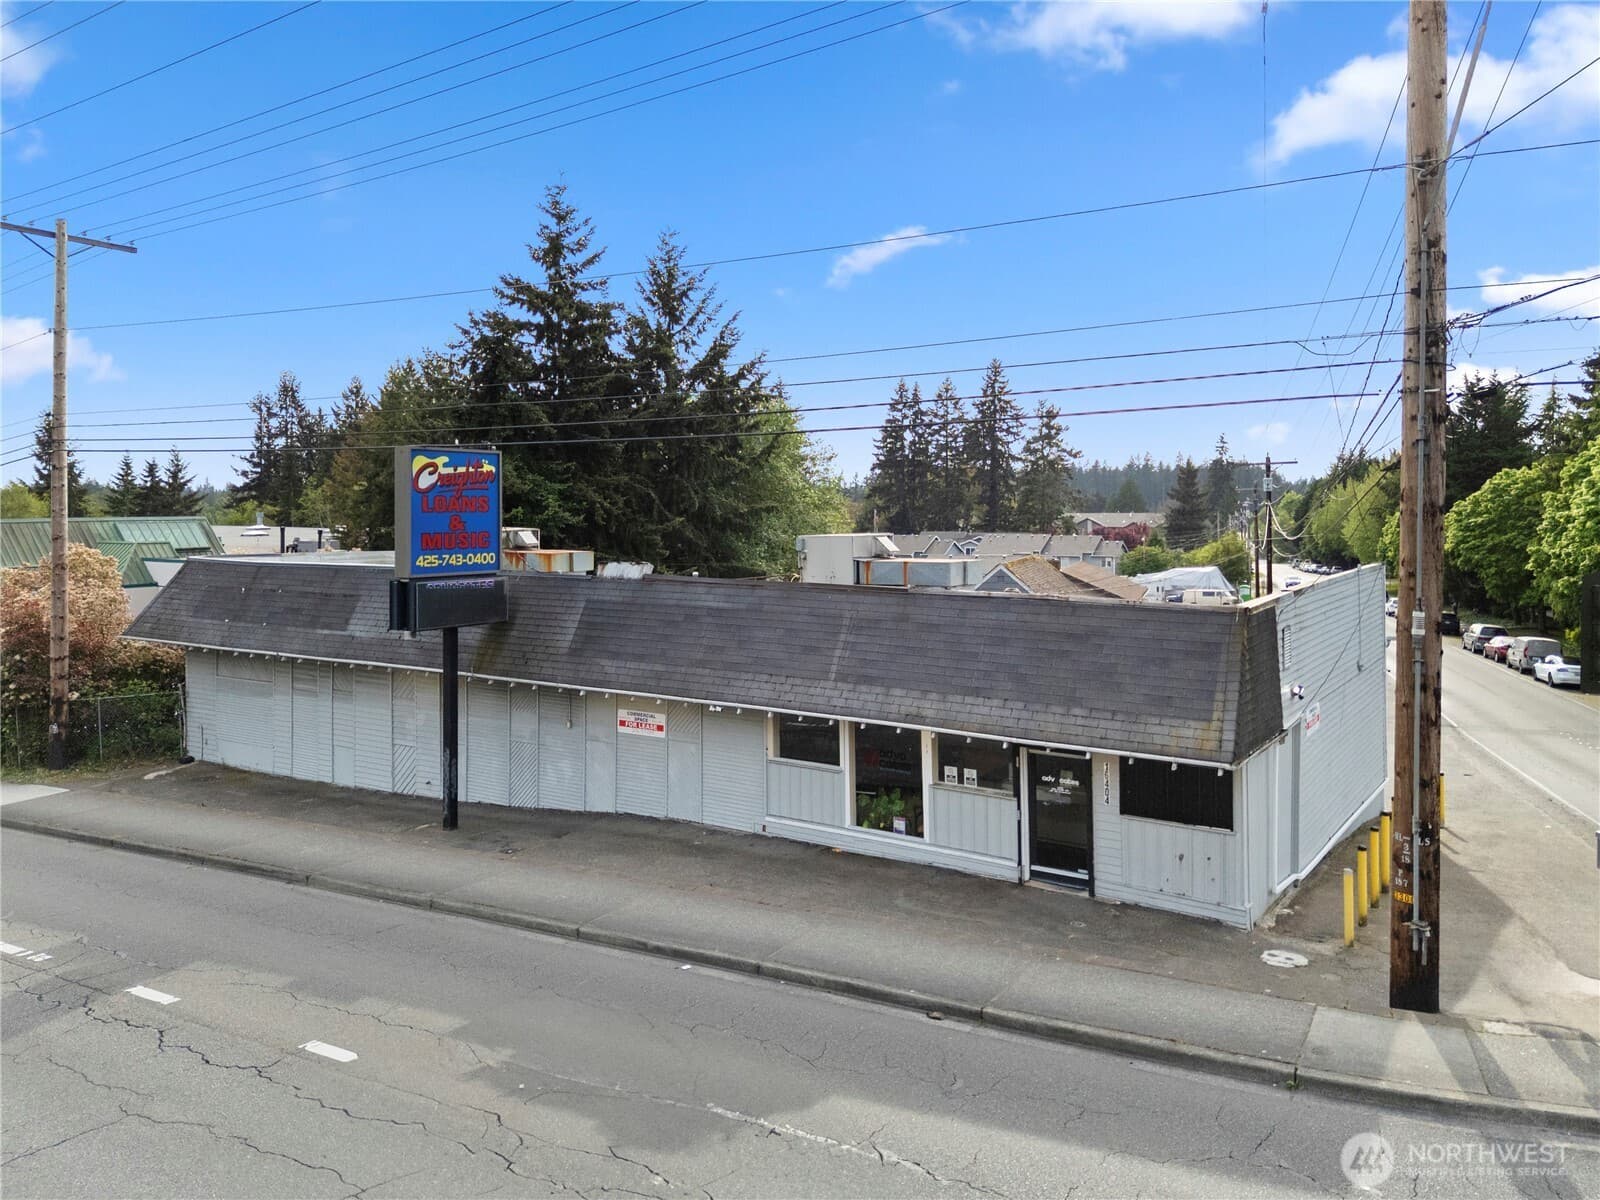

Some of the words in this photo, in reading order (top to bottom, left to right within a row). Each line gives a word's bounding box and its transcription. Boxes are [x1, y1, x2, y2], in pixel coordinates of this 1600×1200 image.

[413, 457, 496, 496] Creighton
[421, 495, 490, 513] LOANS
[448, 514, 466, 531] &
[420, 532, 490, 550] MUSIC
[416, 552, 495, 567] 425-743-0400
[625, 720, 637, 728] FOR
[639, 722, 657, 731] LEASE
